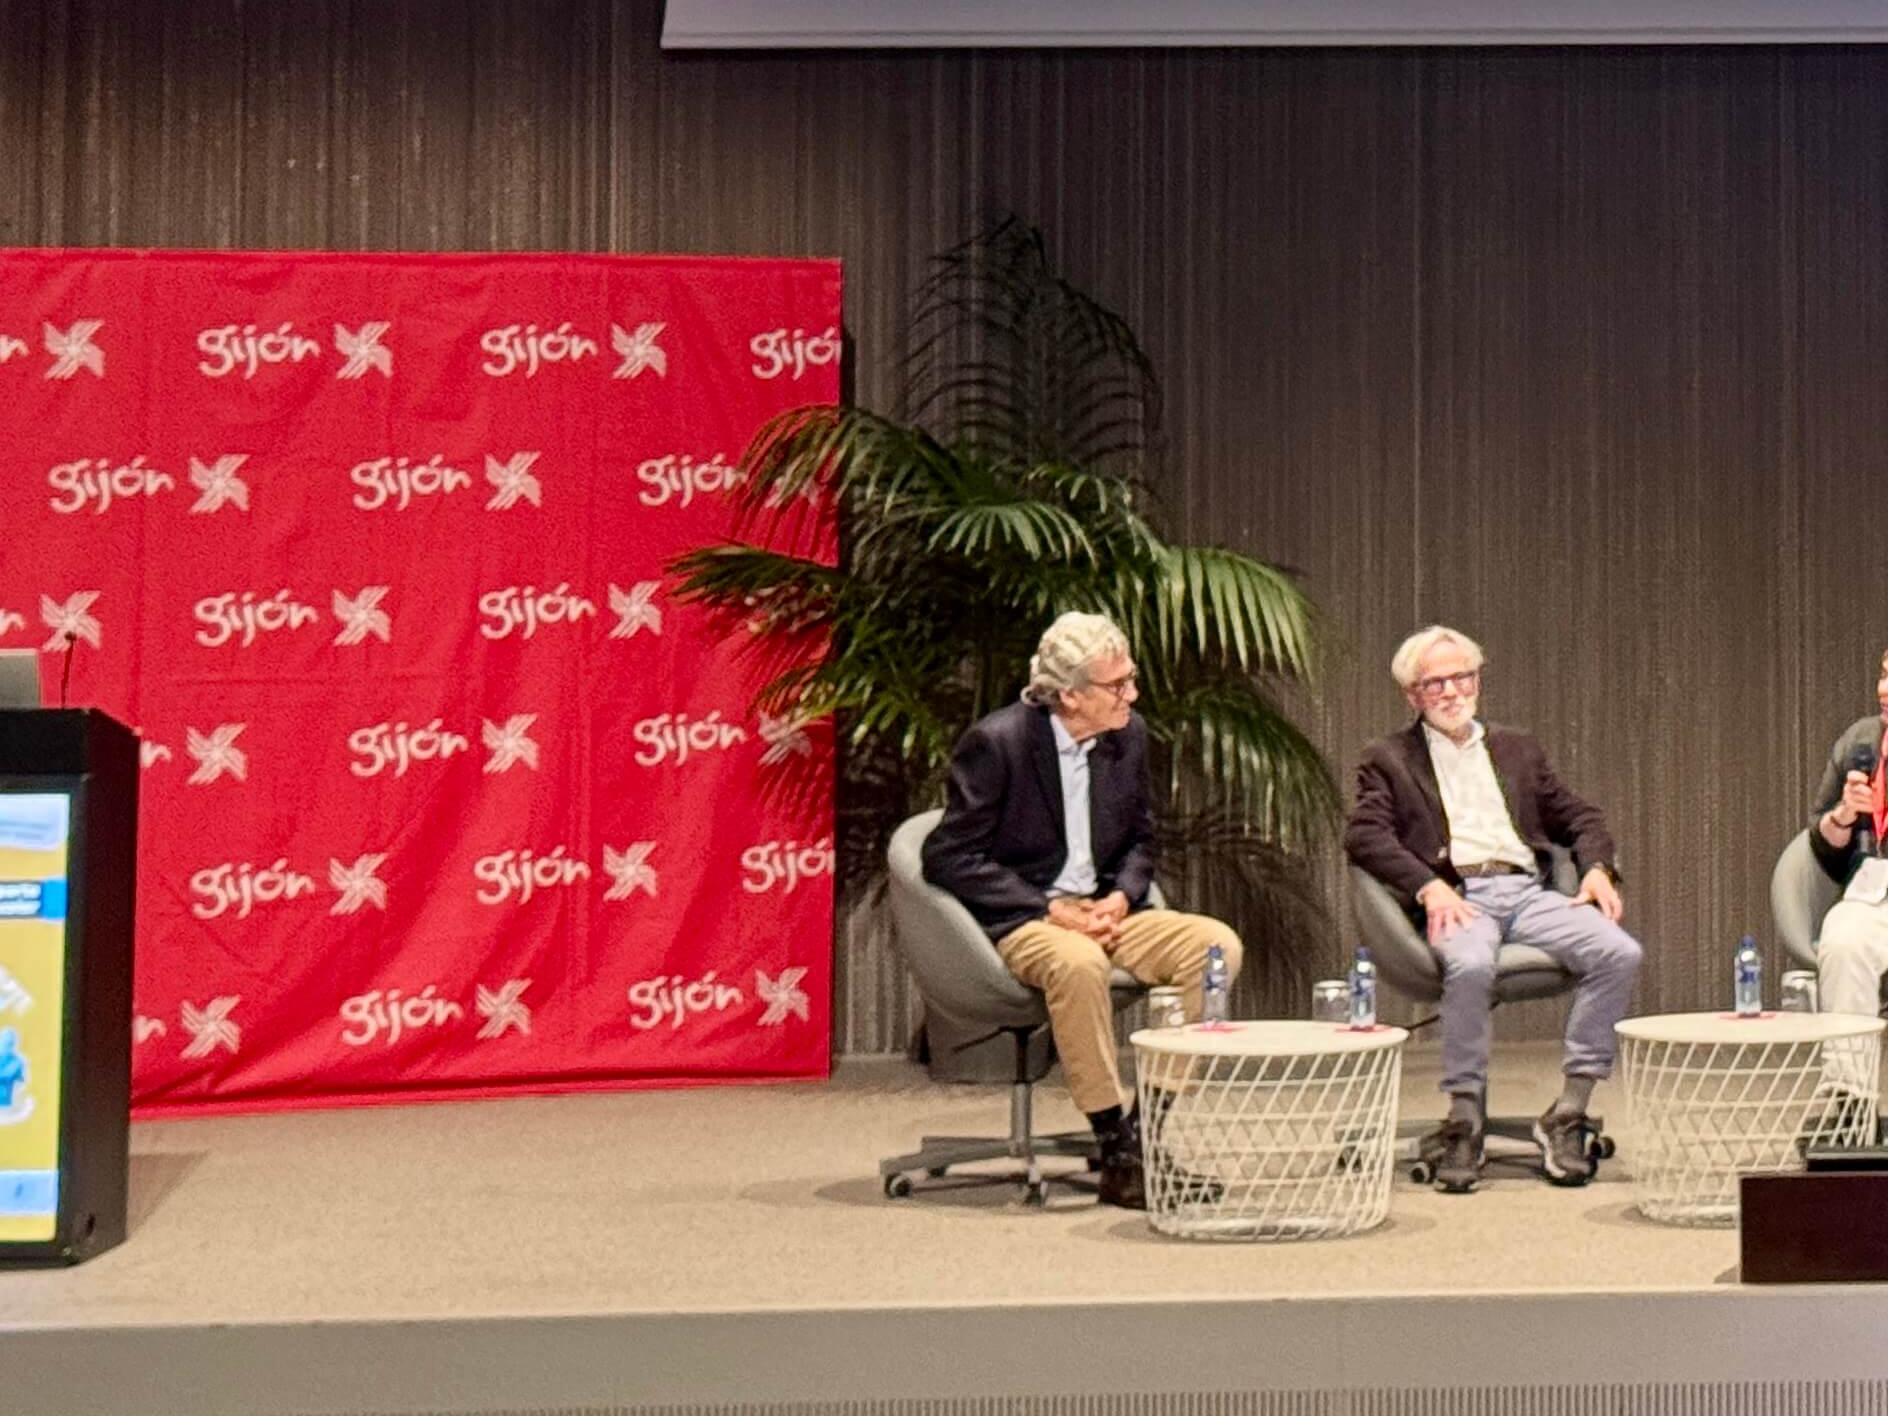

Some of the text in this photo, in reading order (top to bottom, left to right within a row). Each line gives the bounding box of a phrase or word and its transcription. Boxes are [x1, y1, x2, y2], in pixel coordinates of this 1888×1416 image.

[197, 322, 321, 379] gijón
[480, 322, 598, 378] gijón
[48, 456, 175, 515] gijón
[350, 454, 472, 511] gijón
[194, 589, 319, 648] gijón
[478, 582, 596, 640] gijón
[348, 718, 468, 778] gijón
[633, 710, 746, 767] gijón
[190, 858, 316, 919] gijón
[473, 845, 592, 905] gijón
[339, 985, 462, 1047] gijón
[628, 970, 743, 1030] gijón
